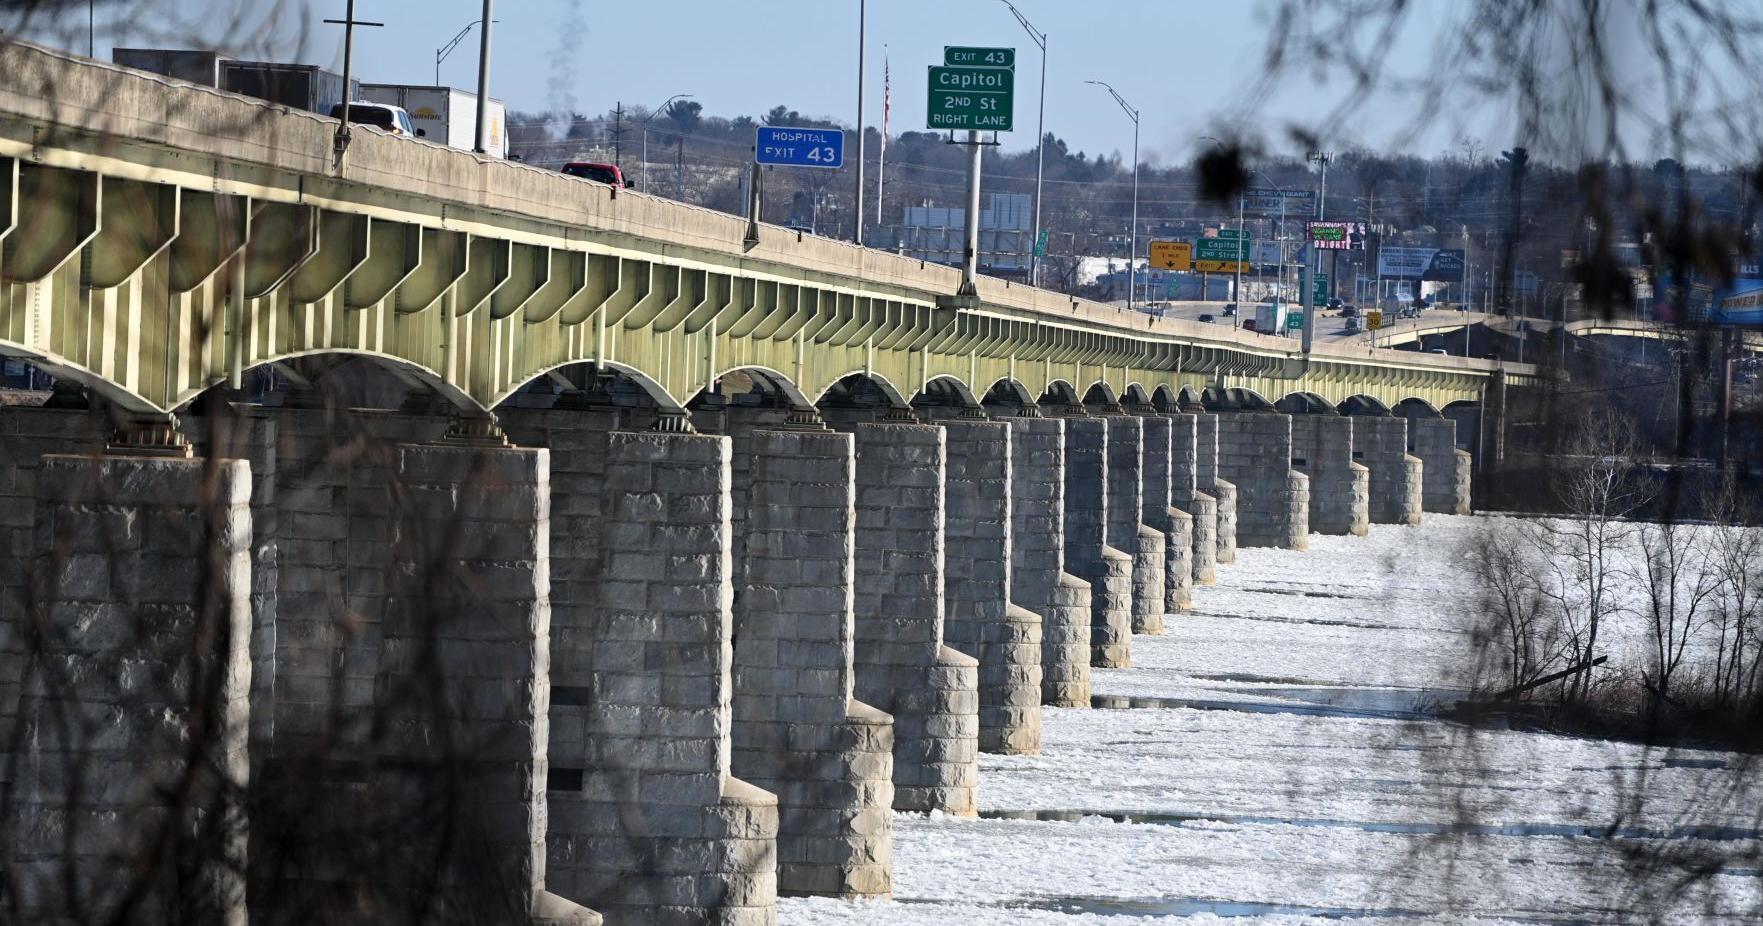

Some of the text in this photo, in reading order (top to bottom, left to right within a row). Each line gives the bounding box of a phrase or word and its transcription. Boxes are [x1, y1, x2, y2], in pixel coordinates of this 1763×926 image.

[954, 51, 1006, 64] EXIT 43
[940, 72, 1003, 88] Capitol
[944, 96, 997, 110] 2ND St
[409, 111, 441, 120] Sunstate
[933, 113, 1007, 126] RIGHT LANE
[772, 131, 828, 143] HOSPITAL
[765, 146, 835, 163] EXIT 43
[1208, 241, 1240, 250] Capitol
[1314, 240, 1346, 249] ONIGHT
